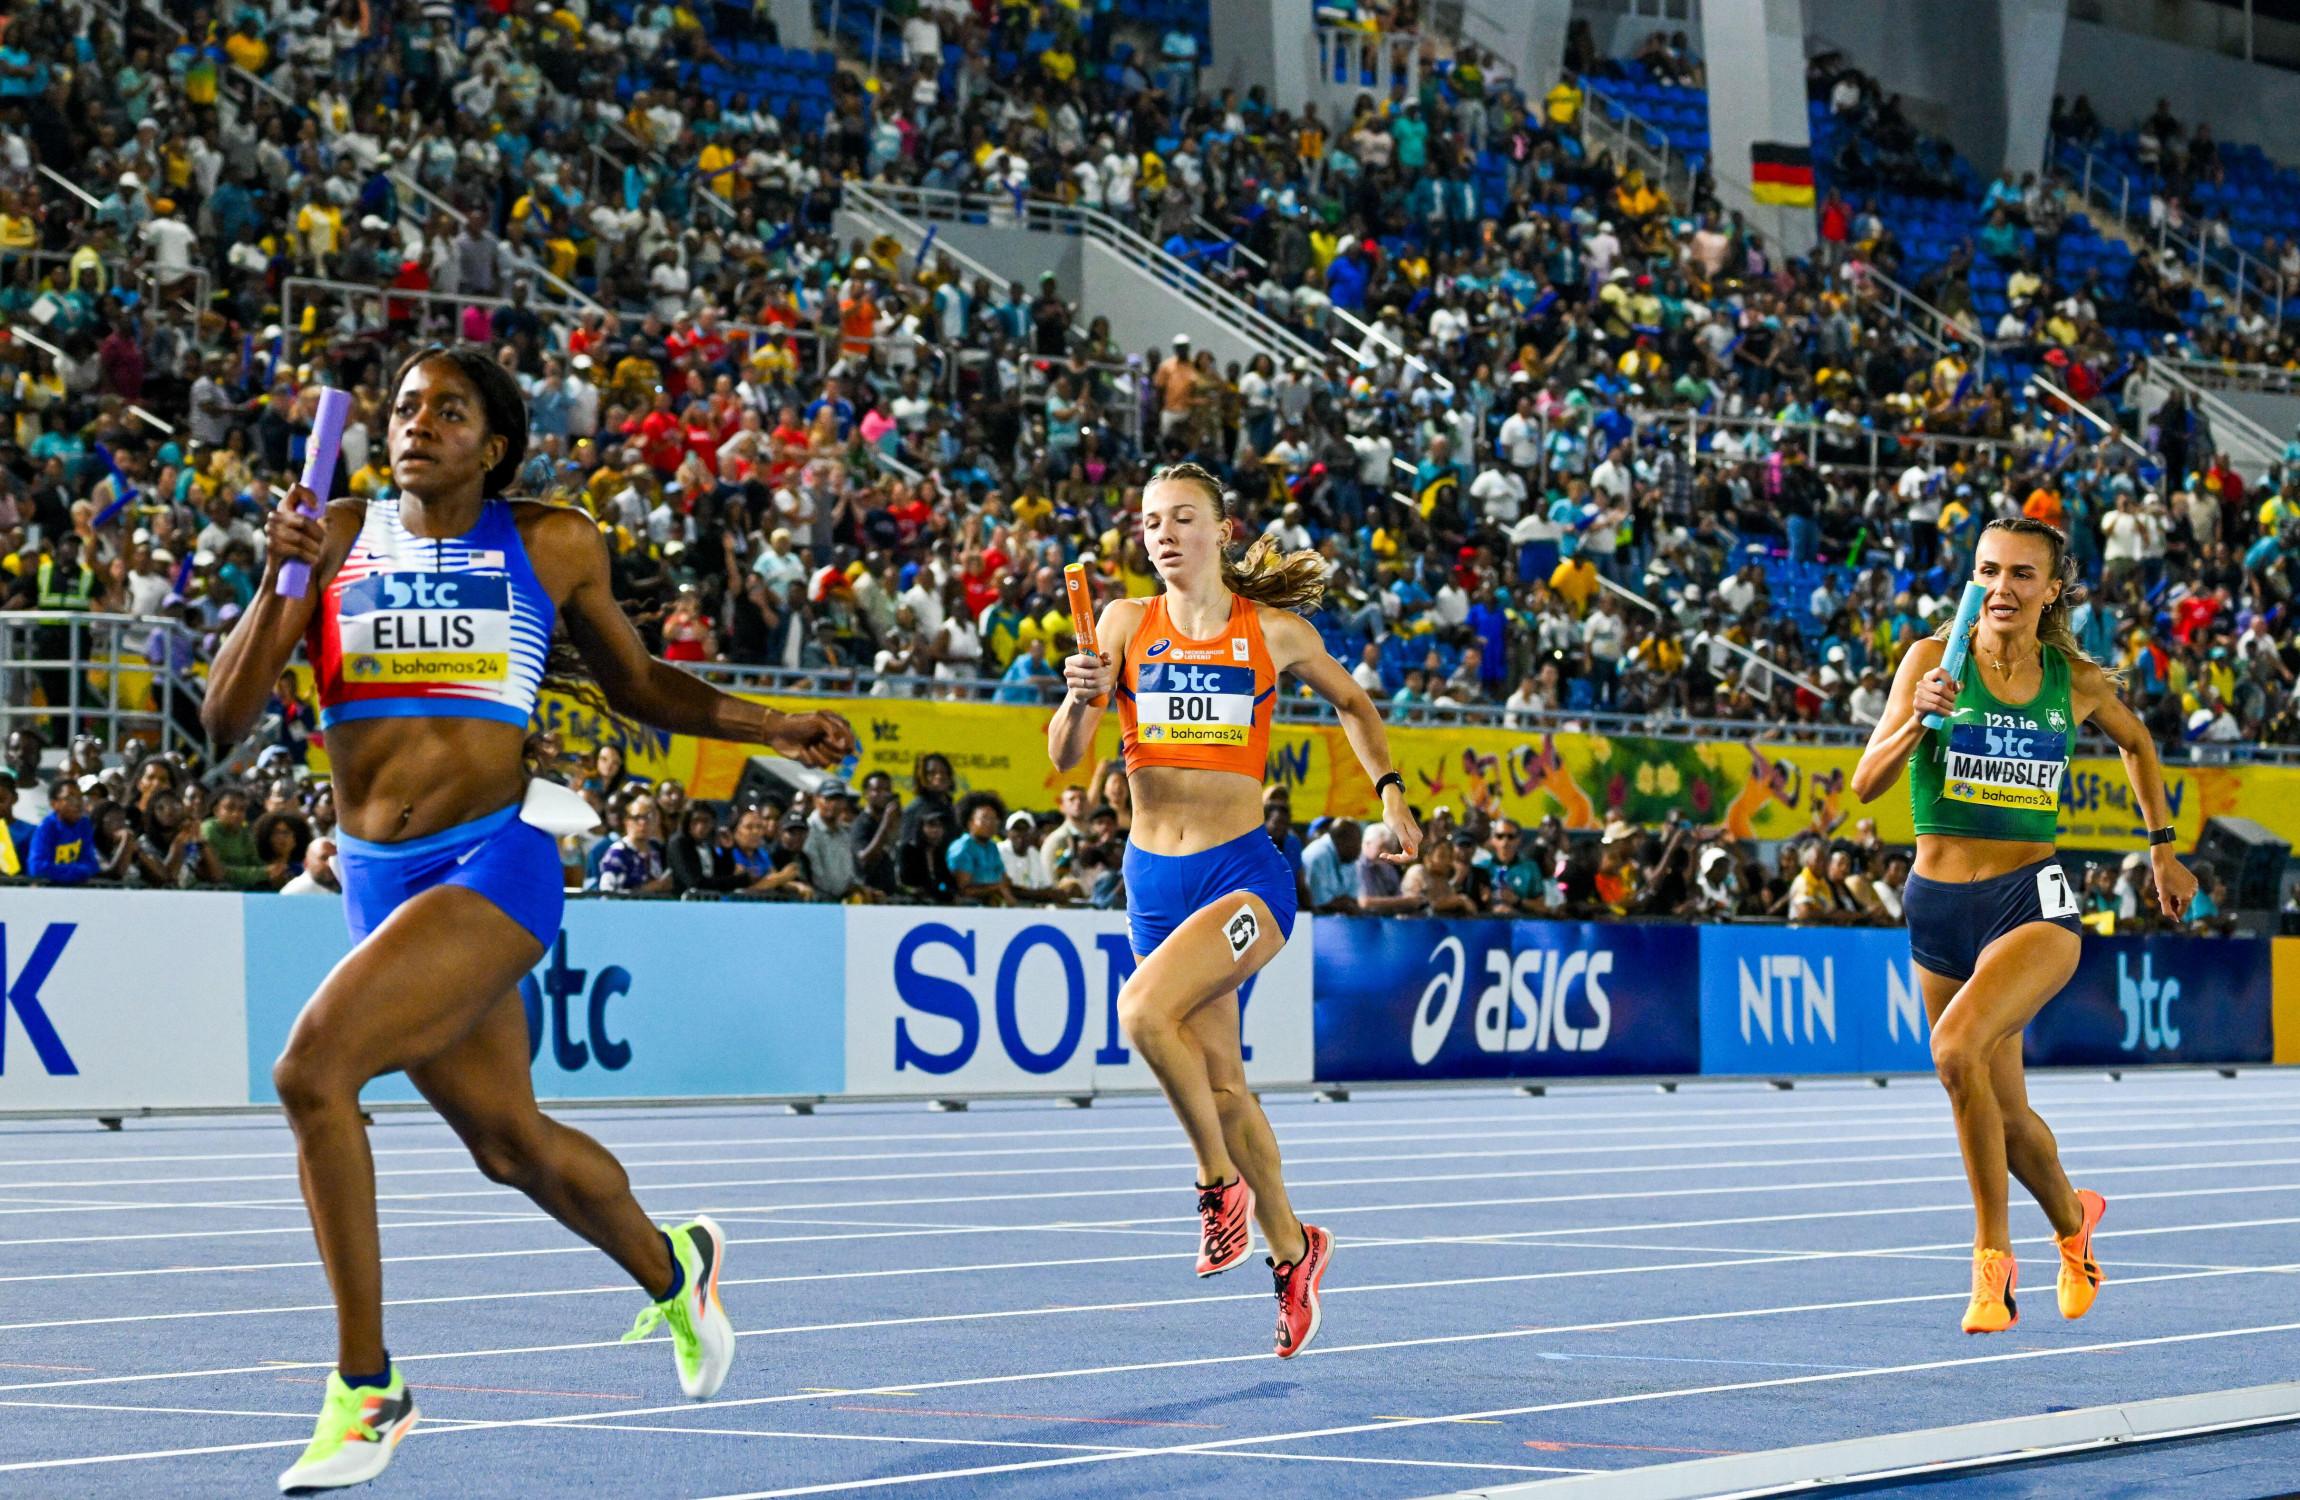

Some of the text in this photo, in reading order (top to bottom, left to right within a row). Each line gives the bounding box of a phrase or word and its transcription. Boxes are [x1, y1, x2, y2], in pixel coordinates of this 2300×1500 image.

[384, 573, 459, 608] btc
[373, 614, 475, 650] ELLIS
[391, 658, 498, 675] bahamas24
[1168, 664, 1221, 692] btc
[1168, 696, 1220, 721] BOL
[1983, 712, 2039, 731] 123.ie
[1170, 727, 1243, 741] bahamas24
[1985, 728, 2035, 758] btc
[1952, 755, 2060, 789] MAWDSLEY
[1981, 788, 2053, 807] bahamas24
[2049, 872, 2067, 909] 7
[1229, 913, 1256, 952] 6
[1738, 954, 1837, 1046] NTN
[2116, 951, 2181, 1051] btc
[1304, 1231, 1321, 1281] balance
